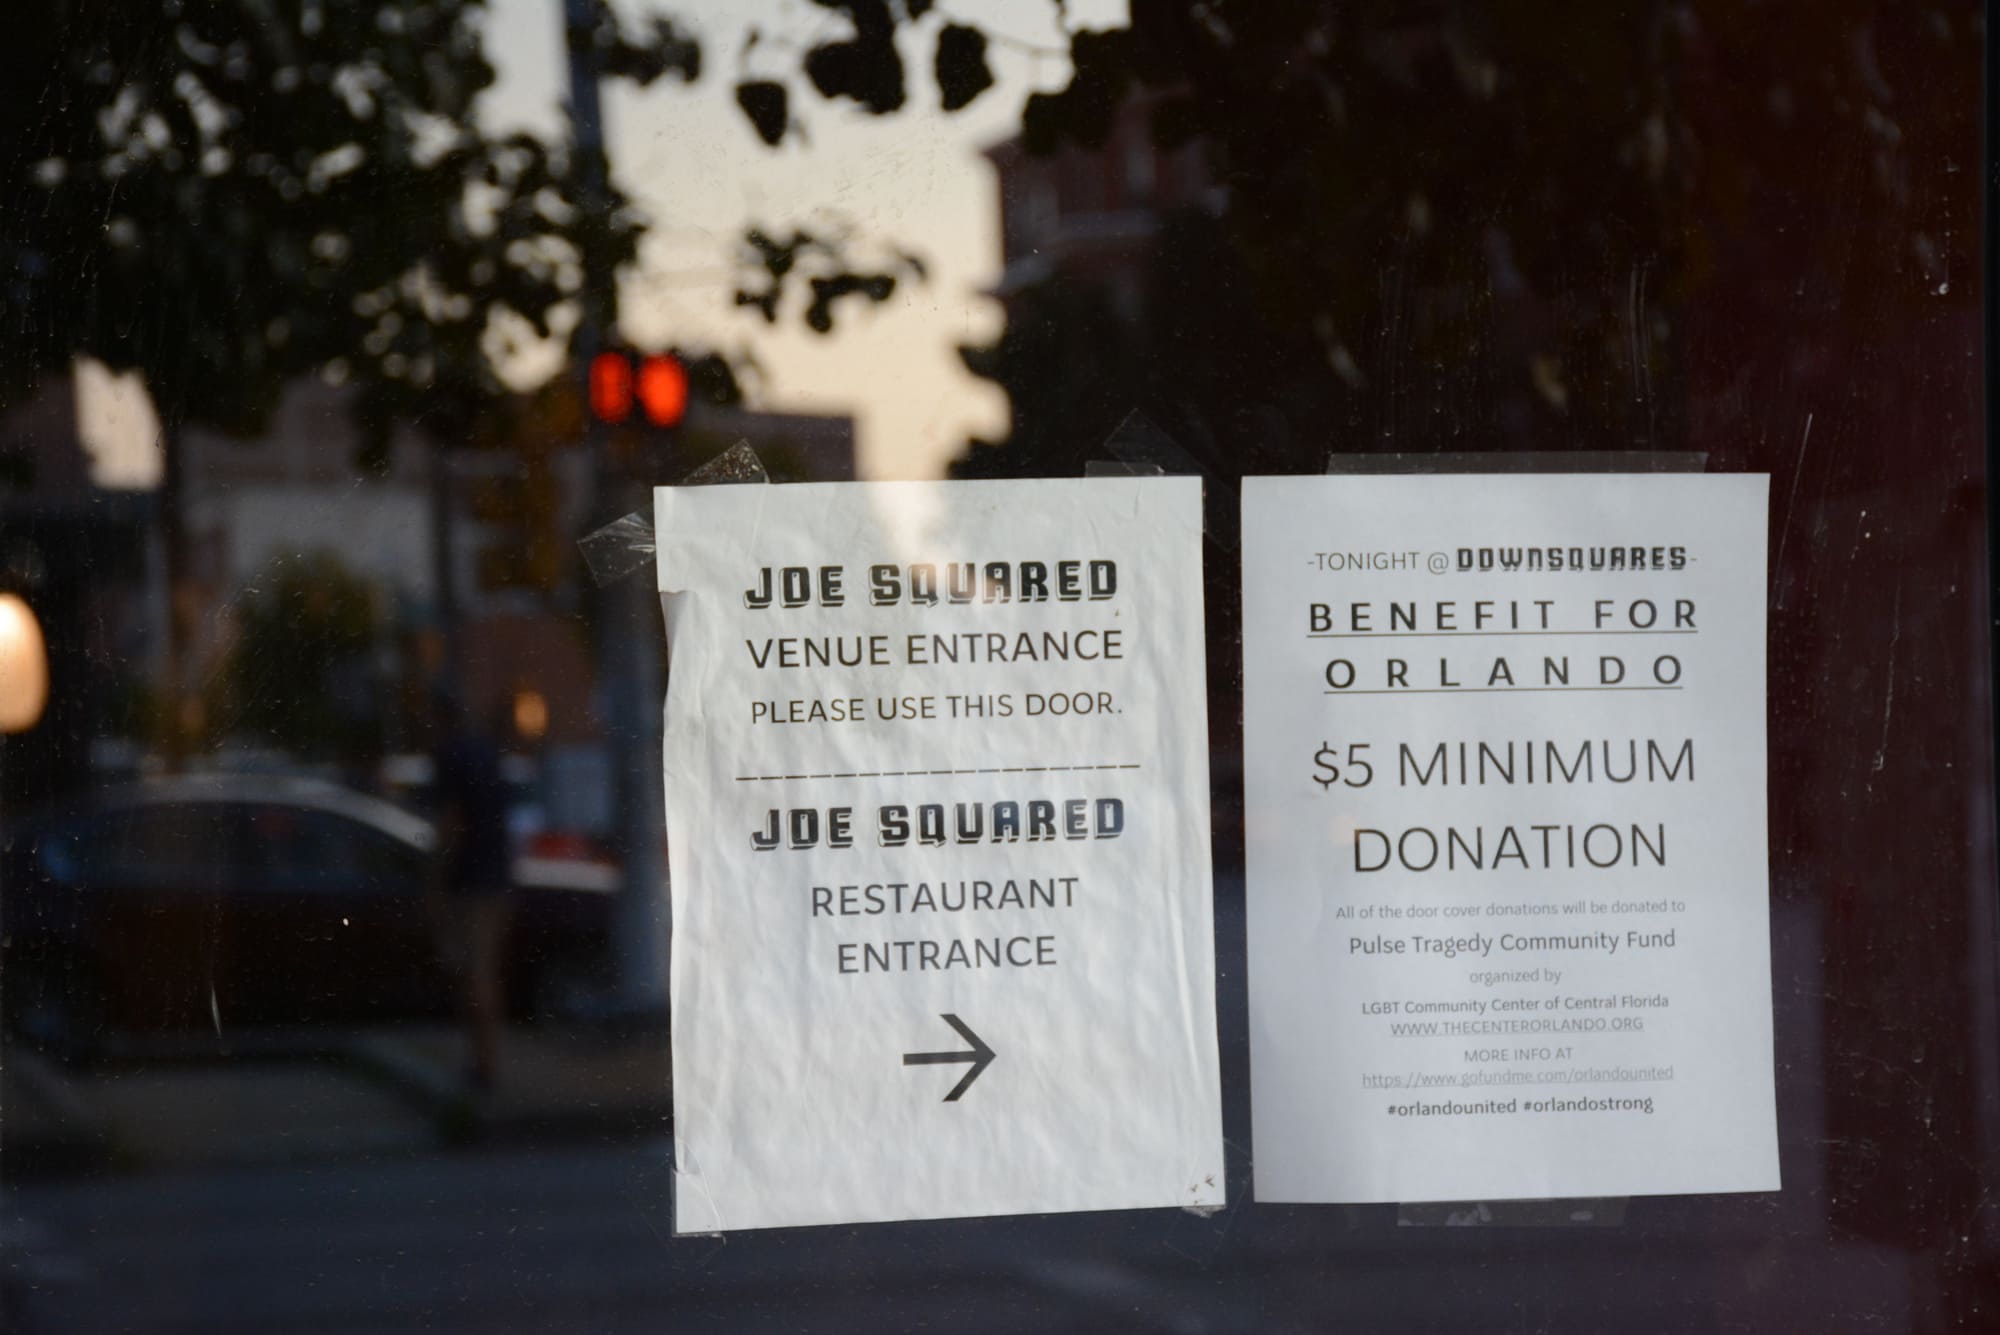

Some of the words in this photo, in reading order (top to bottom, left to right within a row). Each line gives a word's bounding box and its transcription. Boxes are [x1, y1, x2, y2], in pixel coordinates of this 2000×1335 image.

[1427, 552, 1449, 575] @
[745, 566, 844, 609] JOE
[871, 560, 1117, 606] SQUARED
[1310, 601, 1554, 631] BENEFIT
[1595, 600, 1695, 629] FOR
[746, 636, 890, 668] VENUE
[908, 630, 1123, 664] ENTRANCE
[1326, 655, 1681, 688] ORLANDO
[752, 699, 864, 724] PLEASE
[878, 697, 936, 720] USE
[947, 694, 1013, 718] THIS
[1026, 692, 1122, 715] DOOR.
[1313, 741, 1373, 790] $5
[1400, 739, 1694, 786] MINIMUM
[752, 807, 853, 851] JOE
[880, 798, 1124, 847] SQUARED
[1354, 824, 1665, 872] DONATION
[813, 878, 1078, 917] RESTAURANT
[1336, 906, 1354, 919] All
[1360, 905, 1374, 919] of
[1379, 905, 1402, 918] the
[1406, 904, 1438, 918] door
[1443, 906, 1481, 917] cover
[1486, 903, 1558, 916] donations
[1562, 901, 1585, 914] will
[1590, 901, 1607, 914] be
[1611, 899, 1667, 913] donated
[1672, 900, 1685, 912] to
[838, 936, 1056, 974] ENTRANCE
[1350, 935, 1405, 954] Pulse
[1412, 933, 1493, 958] Tragedy
[1500, 932, 1619, 954] Community
[1627, 928, 1675, 948] Fund
[1470, 968, 1539, 987] organized
[1544, 968, 1562, 985] by
[1362, 1002, 1400, 1015] LGBT
[1405, 1000, 1486, 1015] Community
[1492, 999, 1539, 1011] Center
[1545, 996, 1560, 1010] of
[1564, 995, 1616, 1010] Central
[1622, 994, 1669, 1008] Florida
[1464, 1049, 1508, 1062] MORE
[1515, 1048, 1551, 1060] INFO
[1555, 1048, 1573, 1059] AT
[1362, 1065, 1673, 1090] https//www.gofundme.com/orlandounited
[1388, 1098, 1516, 1116] #orlandounited
[1524, 1097, 1654, 1114] #orlandostrong
